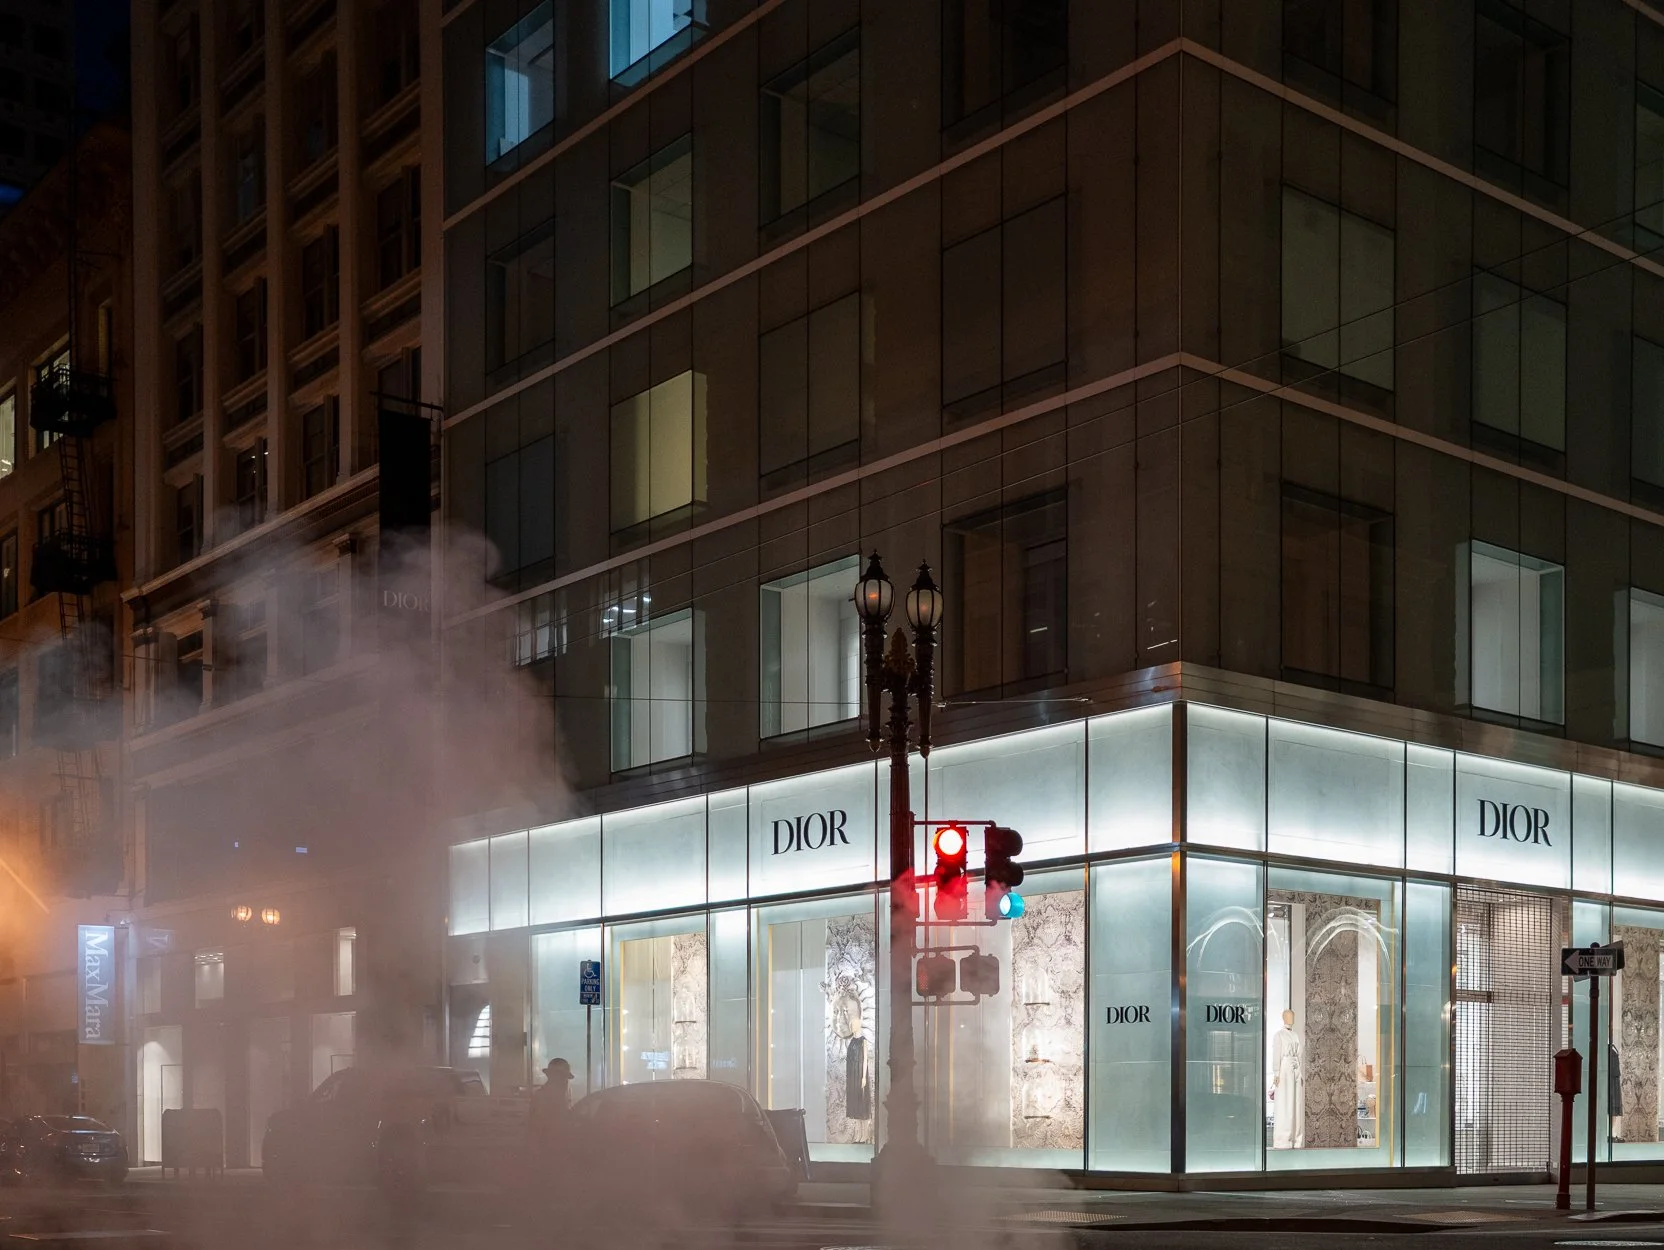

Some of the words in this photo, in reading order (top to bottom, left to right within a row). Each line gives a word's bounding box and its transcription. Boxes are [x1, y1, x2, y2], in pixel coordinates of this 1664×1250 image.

[771, 809, 851, 855] DIOR
[1476, 798, 1553, 847] DIOR
[1578, 956, 1595, 968] ONE
[1596, 956, 1612, 968] WAY
[1106, 1005, 1152, 1024] DIOR
[1206, 1004, 1247, 1025] DIOR
